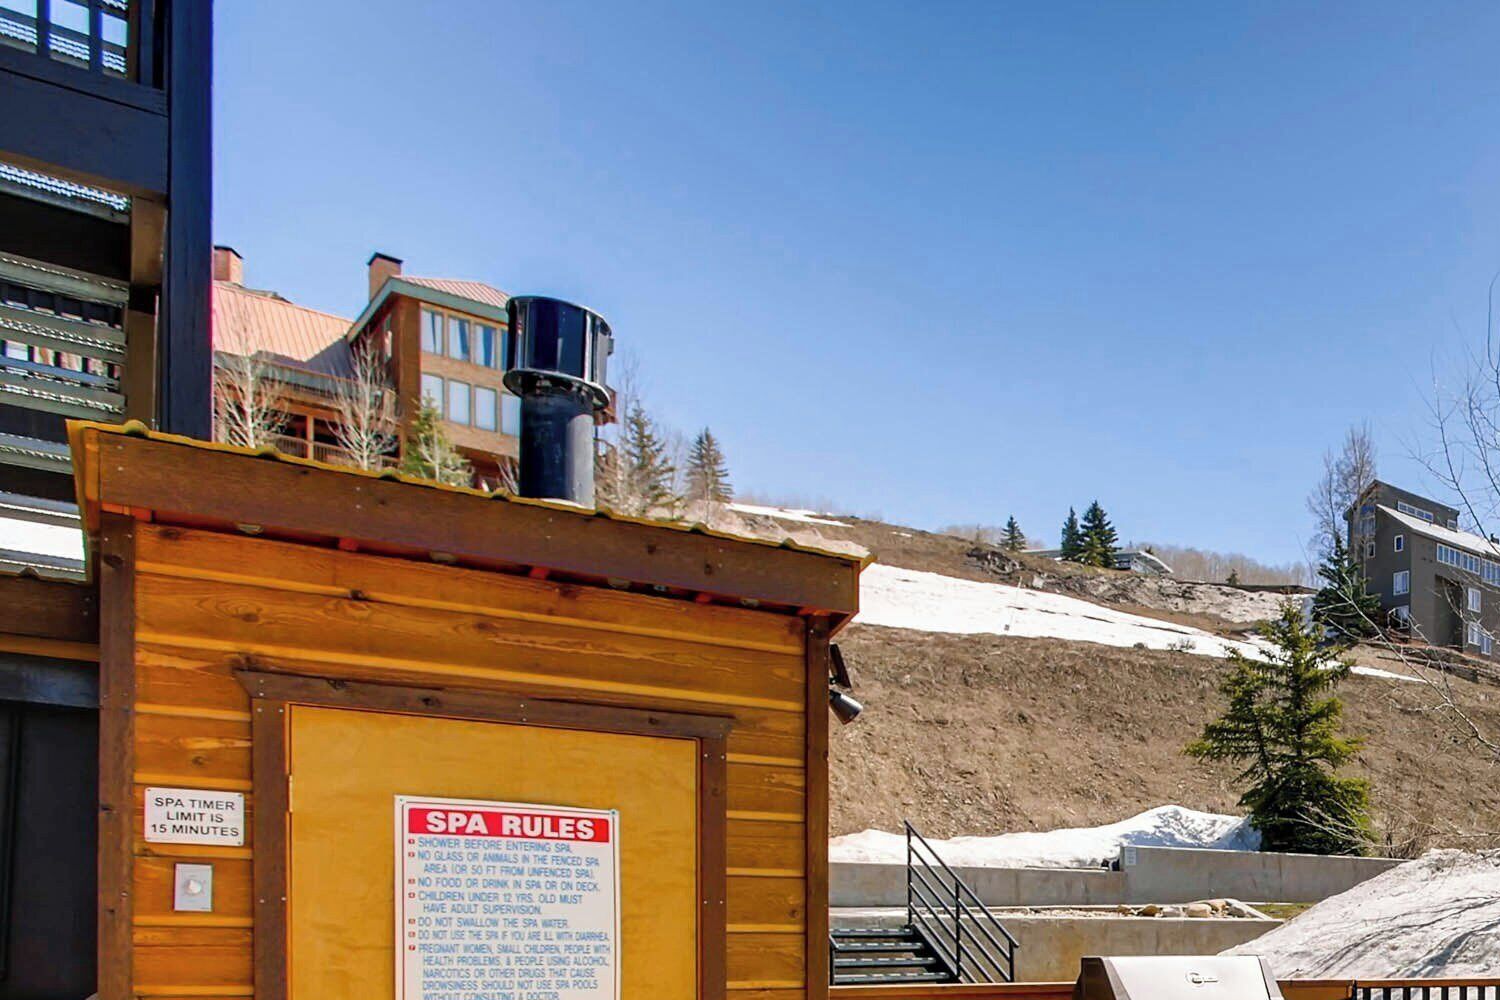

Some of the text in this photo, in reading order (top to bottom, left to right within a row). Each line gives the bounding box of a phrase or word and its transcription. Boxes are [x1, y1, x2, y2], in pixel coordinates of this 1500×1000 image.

[155, 797, 234, 810] SPA TIMER
[166, 811, 224, 823] LIMIT IS
[152, 824, 239, 836] 15 MINUTES
[426, 811, 594, 839] SPA RULES
[418, 836, 460, 848] SHOWER
[464, 839, 502, 850] BEFORE
[506, 841, 551, 852] ENTERING
[418, 850, 430, 860] NO
[434, 851, 463, 861] GLASS
[466, 852, 478, 862] OR
[483, 853, 519, 863] ANIMALS
[522, 854, 529, 864] IN
[533, 855, 548, 864] THE
[552, 856, 582, 866] FENCED
[586, 857, 600, 866] SPA
[424, 864, 448, 873] AREA
[472, 864, 482, 874] 50
[486, 866, 496, 874] FT
[500, 866, 524, 876] FROM
[528, 867, 572, 878] UNFENCED
[418, 877, 432, 887] NO
[435, 878, 462, 888] FOOD
[466, 878, 478, 888] OR
[482, 879, 508, 888] DRINK
[513, 880, 522, 888] IN
[525, 880, 541, 890] SPA
[545, 880, 557, 890] OR
[561, 882, 573, 890] ON
[576, 882, 600, 892] DECK.
[418, 891, 464, 901] CHILDREN
[468, 892, 499, 902] UNDER
[503, 893, 512, 902] 12
[538, 894, 556, 904] OLD
[560, 894, 582, 904] MUST
[424, 903, 542, 914] HAVE ADULT SUPERVISION.
[418, 917, 431, 927] DO
[435, 917, 452, 927] NOT
[457, 917, 498, 928] SWALLOW
[503, 918, 518, 928] THE
[523, 918, 537, 928] SPA
[418, 930, 430, 940] DO
[432, 930, 448, 940] NOT
[452, 930, 464, 940] USE
[468, 930, 482, 940] THE
[486, 930, 498, 940] SPA
[502, 931, 508, 940] IF
[511, 931, 524, 940] YOU
[528, 931, 540, 940] ARE
[544, 932, 554, 940] ILL
[556, 932, 573, 940] WITH
[418, 944, 460, 954] PREGNANT
[497, 944, 521, 954] SMALL
[564, 944, 591, 954] PEOPLE
[594, 944, 610, 954] WITH
[424, 956, 454, 966] HEALTH
[514, 956, 544, 966] PEOPLE
[547, 956, 570, 966] USING
[423, 968, 595, 978] NARCOTICS OR OTHER DRUGS THAT CAUSE
[422, 980, 598, 990] DROWSINESS SHOULD NOT USE SPA POOLS
